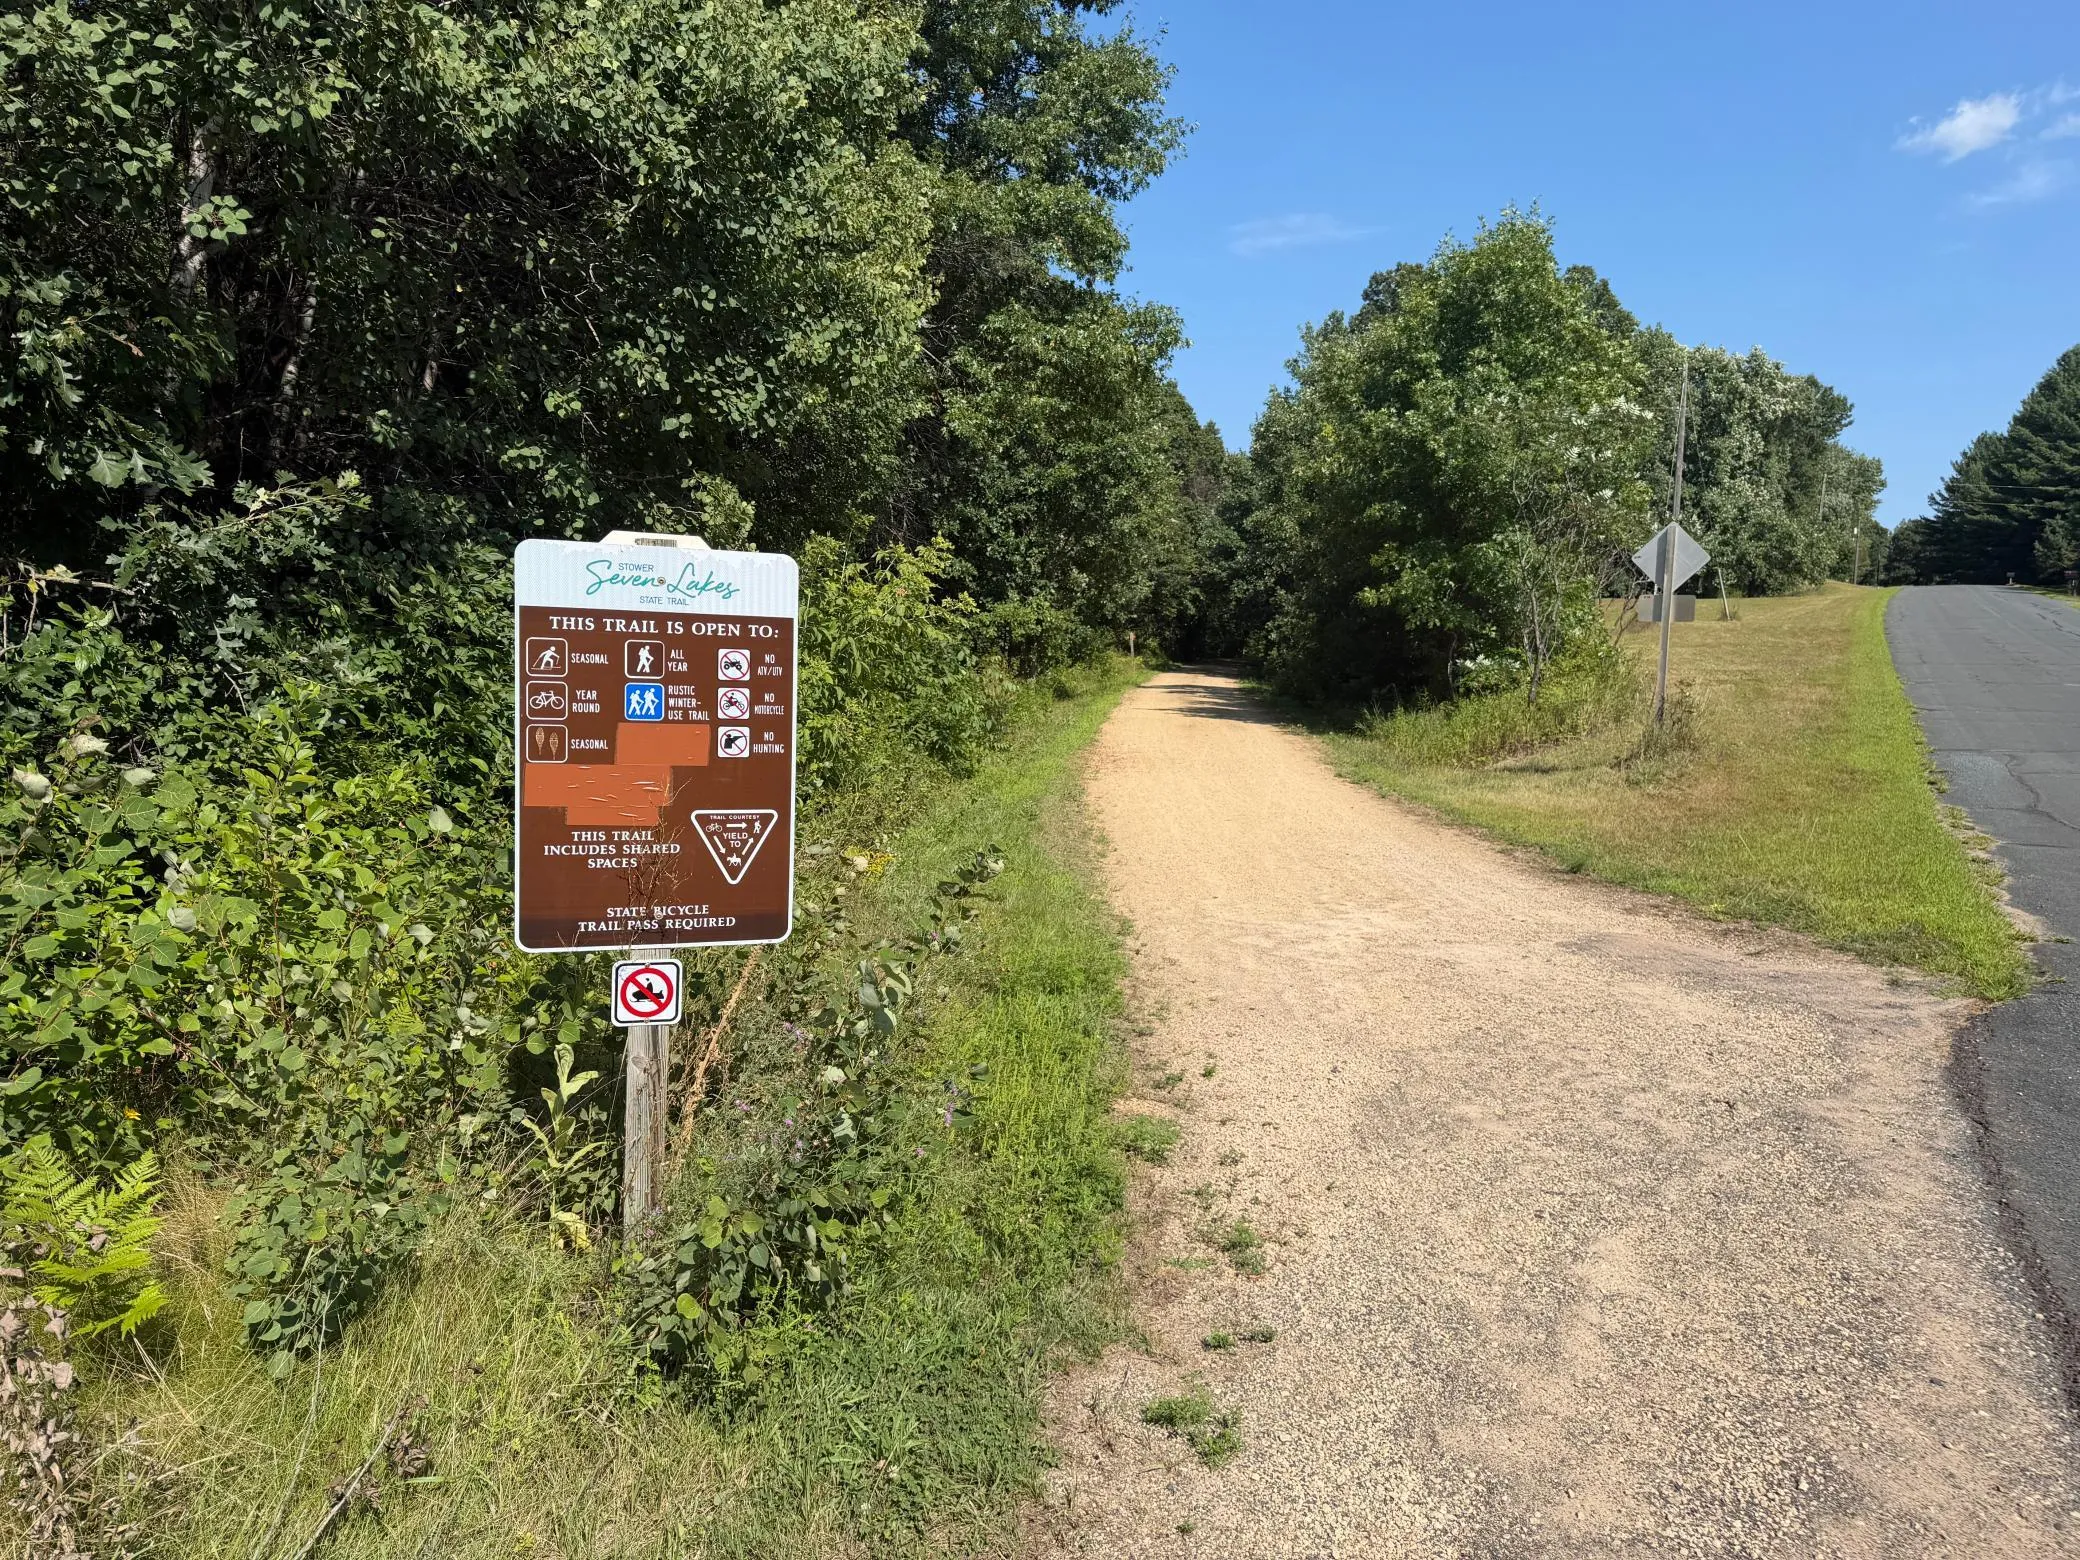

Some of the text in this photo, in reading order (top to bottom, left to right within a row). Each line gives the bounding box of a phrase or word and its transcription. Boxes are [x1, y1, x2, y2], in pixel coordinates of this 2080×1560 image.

[618, 562, 654, 573] STOWER
[585, 559, 741, 599] Seven Lakes
[639, 595, 690, 606] STATE TRAIL
[549, 616, 779, 638] THIS TRAIL IS OPEN TO:
[571, 653, 609, 665] SEASONAL
[670, 649, 685, 660] ALL
[764, 654, 775, 664] NO
[667, 661, 688, 672] YEAR
[757, 666, 783, 676] ATV/UTV
[575, 689, 597, 700] YEAR
[668, 685, 696, 696] RUSTIC
[668, 697, 702, 708] WINTER-
[764, 693, 775, 703] NO
[572, 702, 600, 713] ROUND
[754, 705, 785, 715] MOTORCYCLE
[668, 710, 710, 721] USE TRAIL
[763, 731, 774, 741] NO
[570, 738, 609, 750] SEASONAL
[753, 744, 785, 753] HUNTING
[571, 830, 655, 842] THIS TRAIL
[722, 832, 748, 840] YIELD
[543, 843, 681, 856] INCLUDES SHARED
[730, 840, 741, 848] TO
[587, 857, 638, 869] SPACES
[606, 904, 709, 918] STATE BICYCLE
[578, 916, 736, 932] TRAIL PASS REQUIRED
